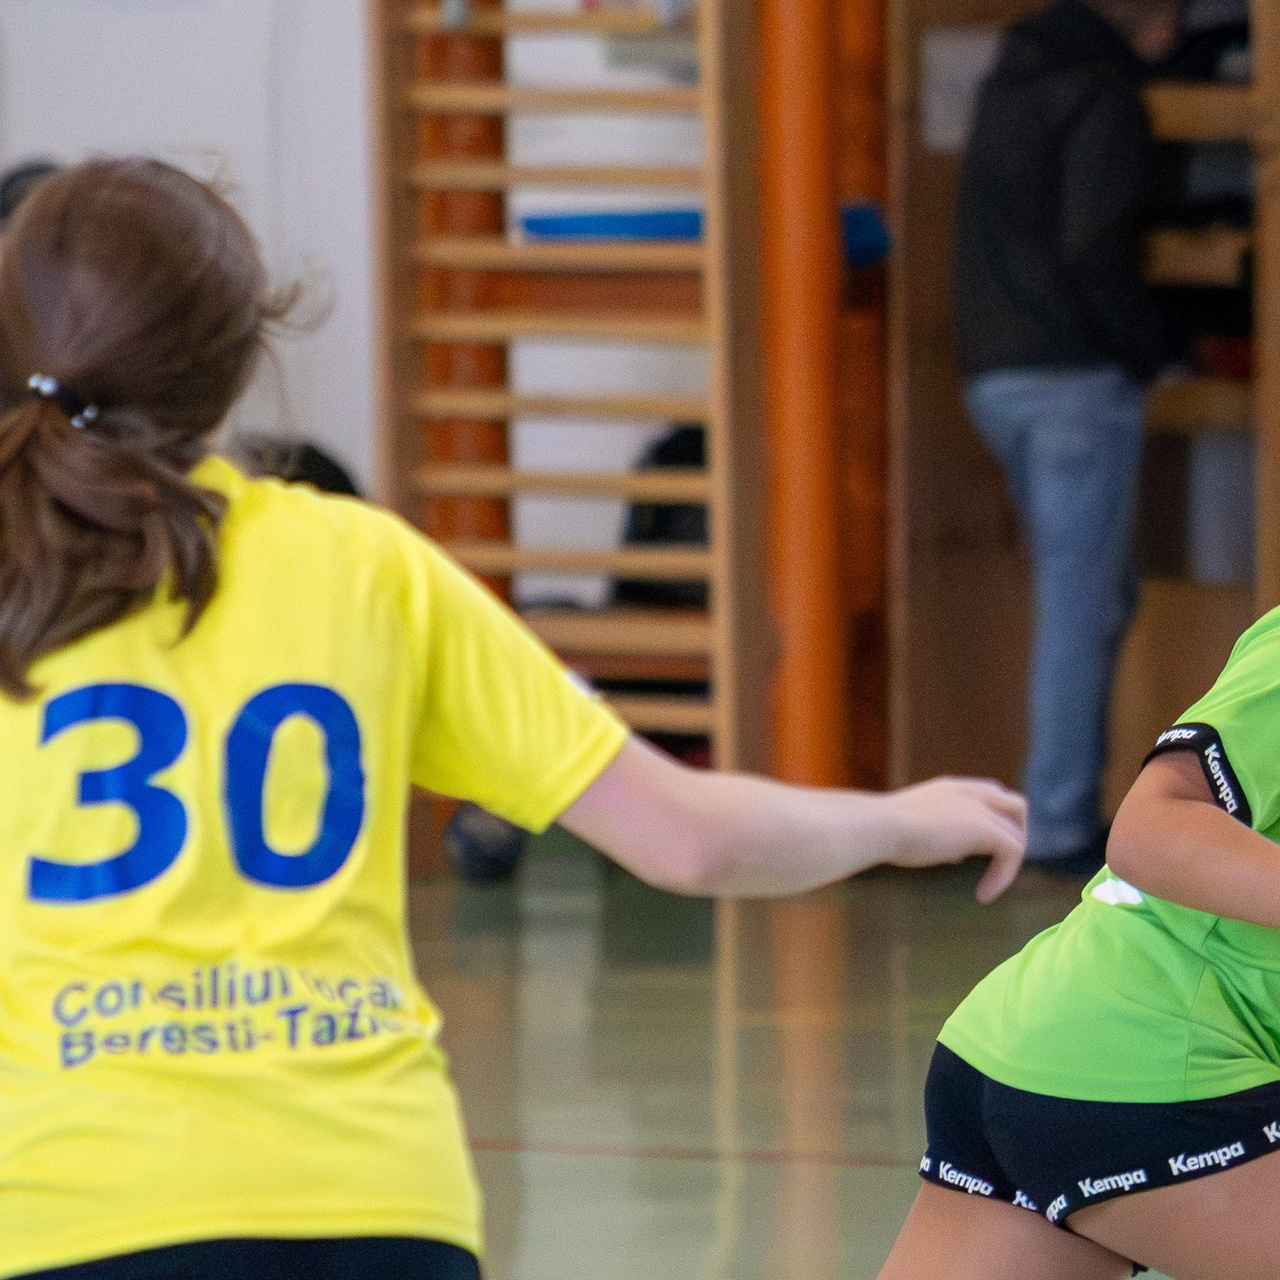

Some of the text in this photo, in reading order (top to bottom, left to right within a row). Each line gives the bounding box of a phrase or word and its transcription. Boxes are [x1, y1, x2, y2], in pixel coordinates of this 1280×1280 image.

[26, 682, 367, 905] 30
[1204, 743, 1238, 814] Kempa
[939, 1161, 994, 1196] Kempa
[1078, 1167, 1147, 1198] Kempa
[1168, 1141, 1245, 1176] Kempa
